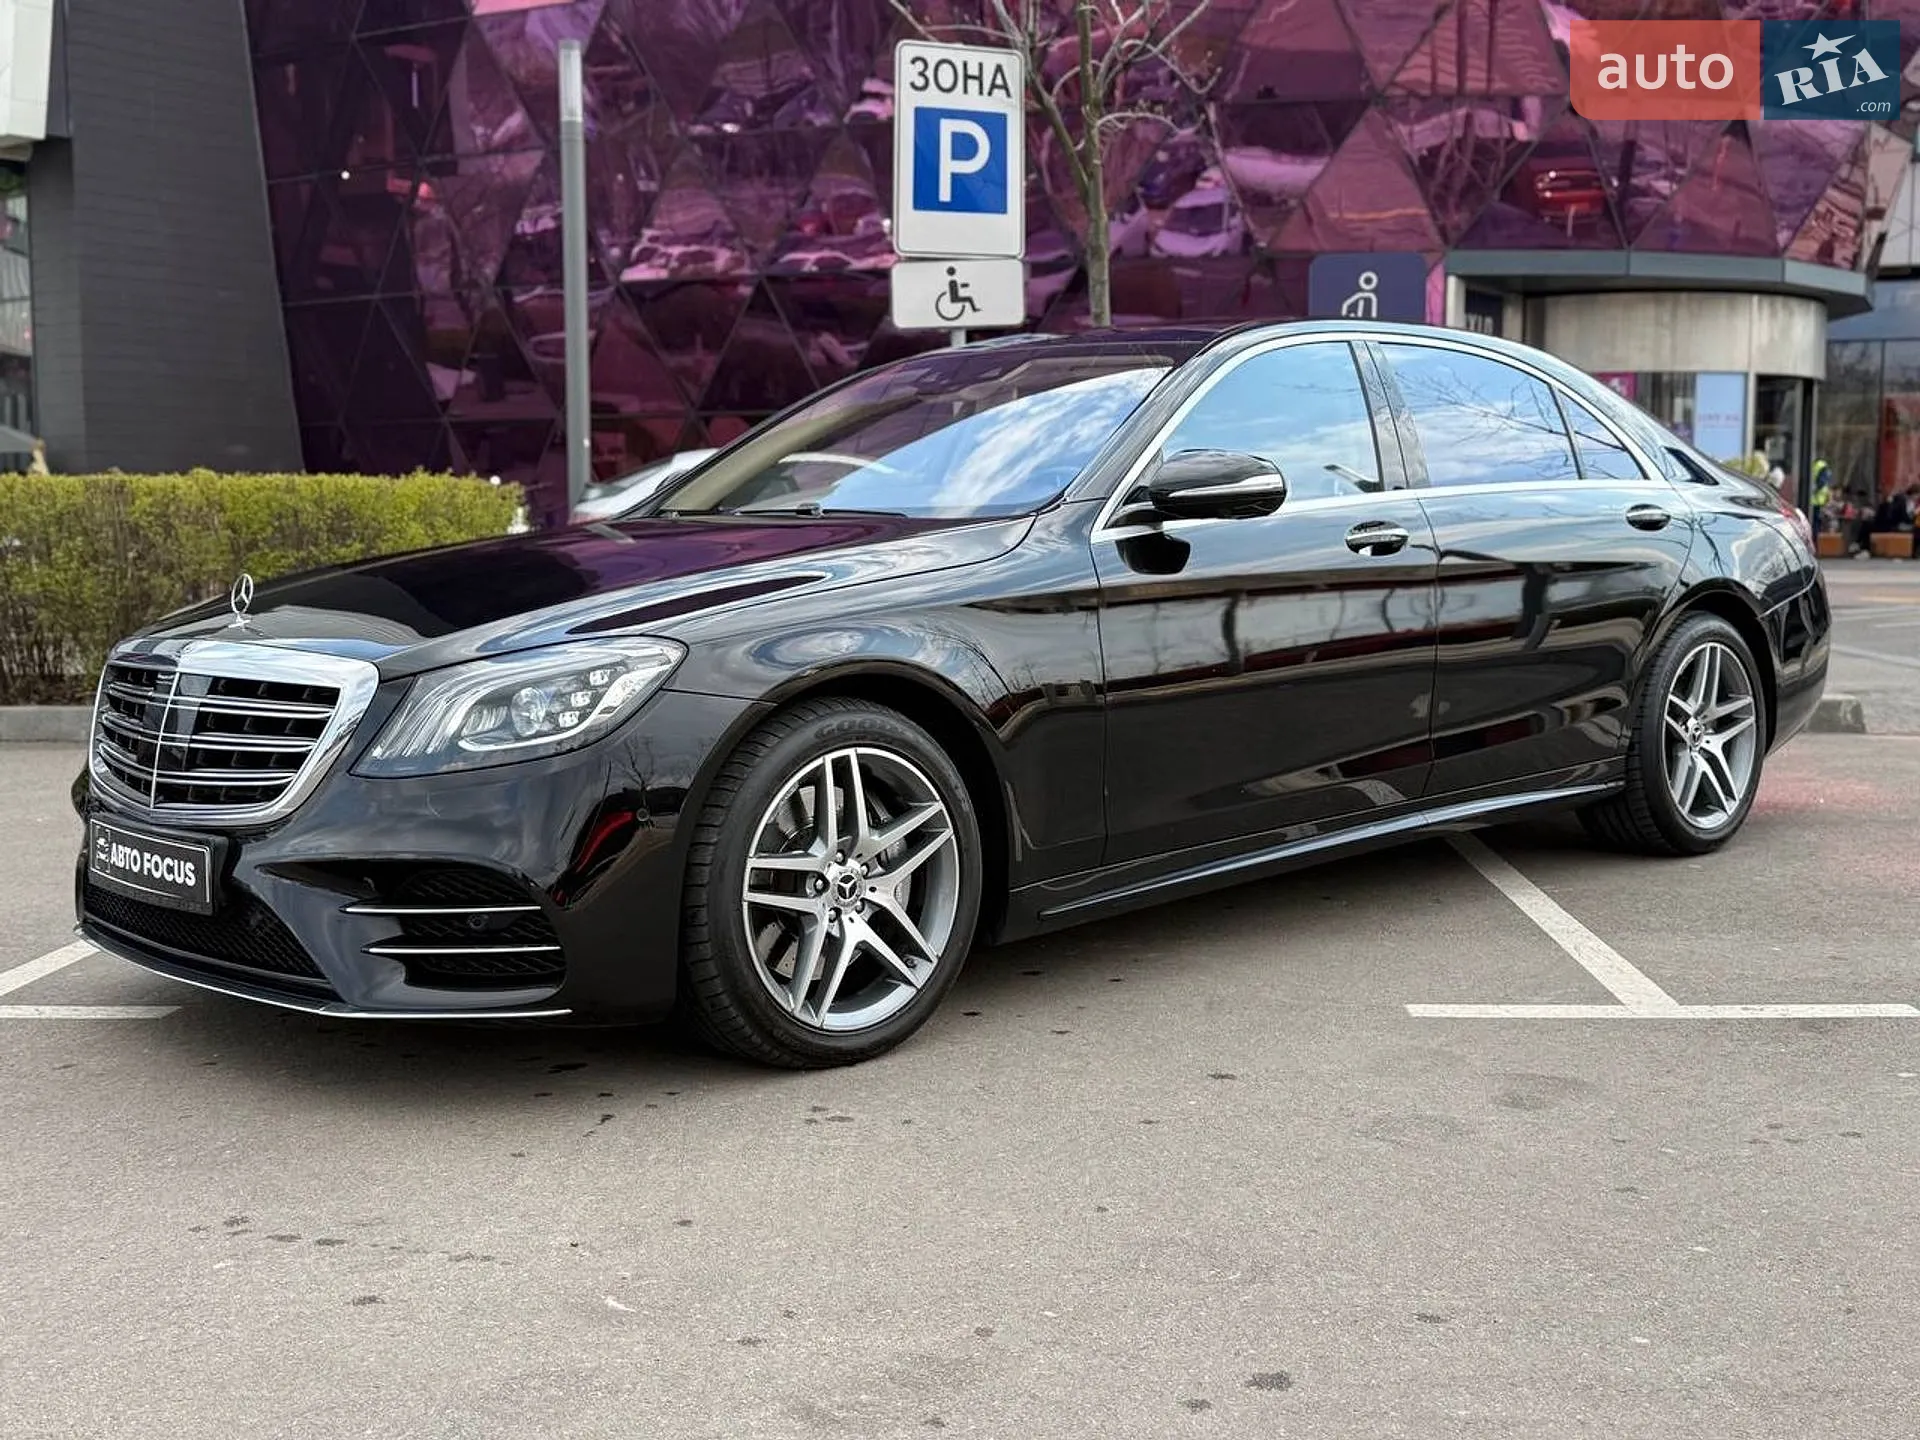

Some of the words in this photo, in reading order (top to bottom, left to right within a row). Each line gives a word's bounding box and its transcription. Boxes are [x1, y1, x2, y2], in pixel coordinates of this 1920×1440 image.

[909, 56, 1012, 98] ЗОНА
[938, 117, 991, 203] P
[143, 851, 196, 887] FOCUS
